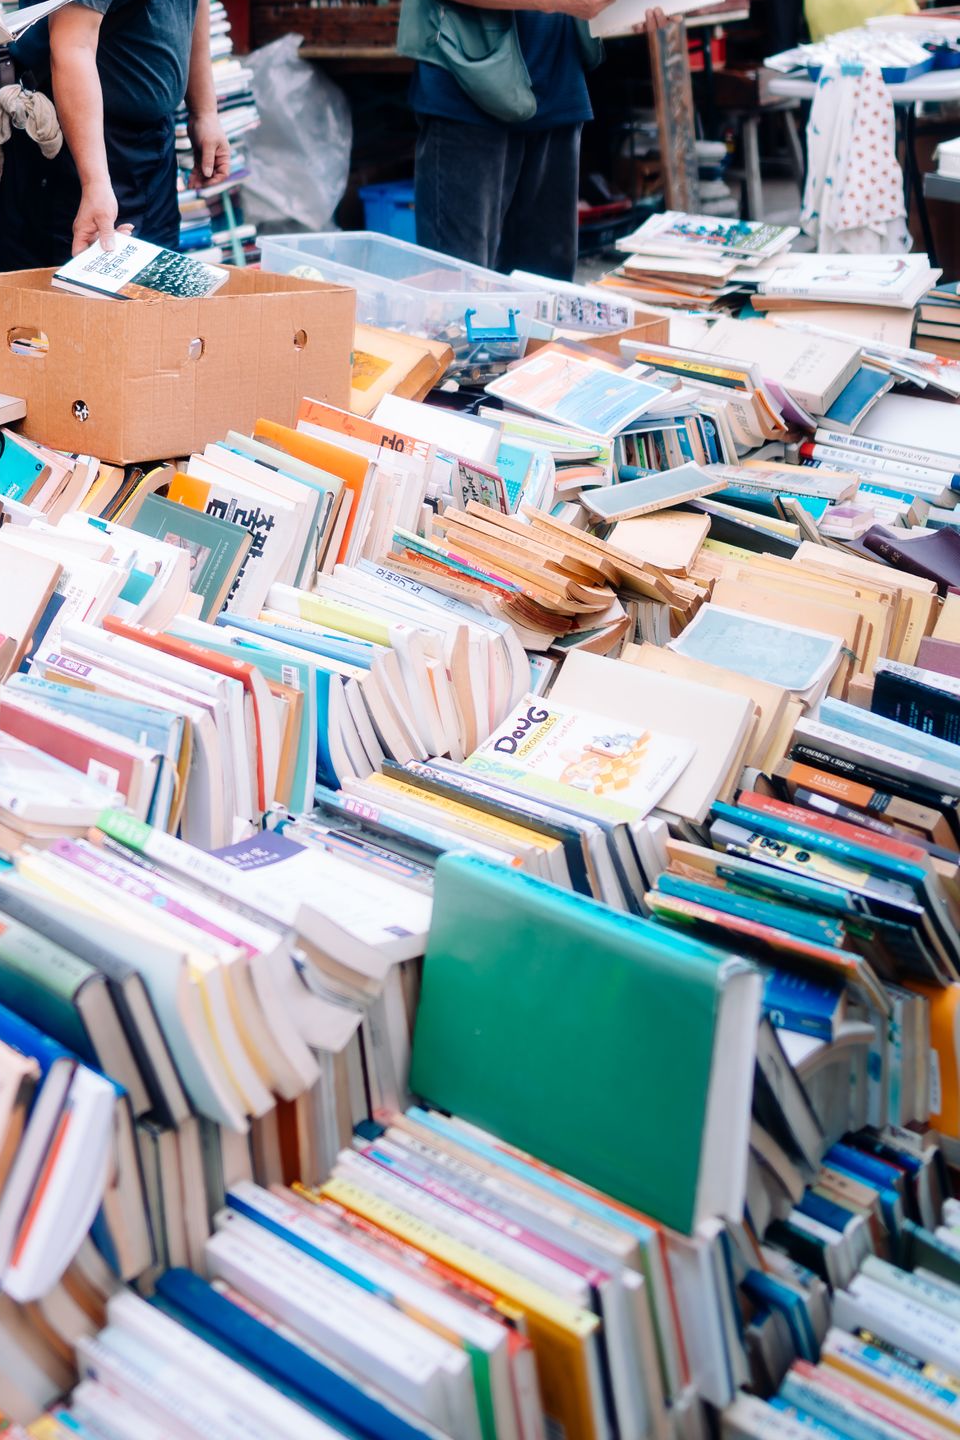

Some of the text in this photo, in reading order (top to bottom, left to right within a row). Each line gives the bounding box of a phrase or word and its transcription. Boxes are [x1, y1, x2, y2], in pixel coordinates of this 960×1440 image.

[518, 717, 558, 757] CHRONICLES
[797, 745, 831, 763] COMMON
[812, 773, 850, 791] HAMLET
